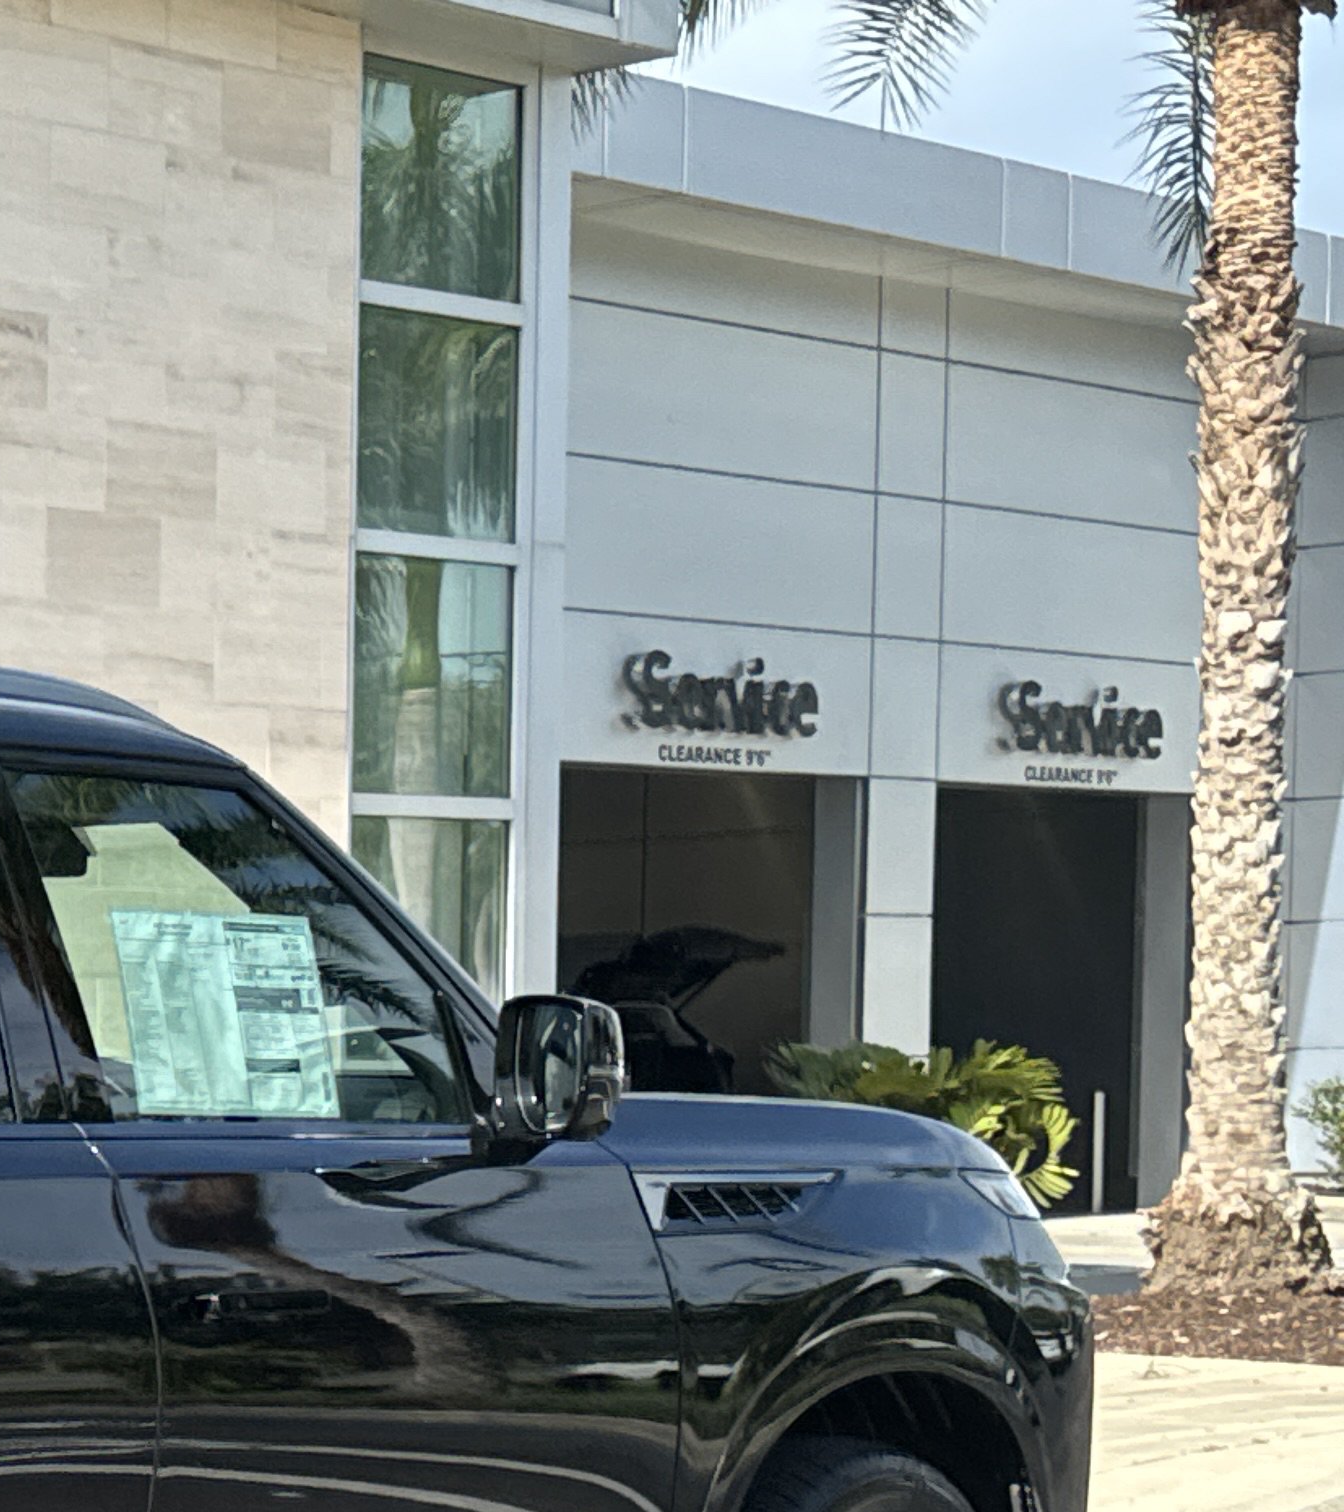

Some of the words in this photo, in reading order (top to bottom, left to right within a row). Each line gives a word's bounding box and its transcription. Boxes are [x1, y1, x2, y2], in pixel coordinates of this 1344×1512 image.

[620, 649, 819, 738] Service
[996, 680, 1164, 760] Service
[657, 744, 743, 765] CLEARANCE
[1023, 765, 1094, 784] CLEARANCE
